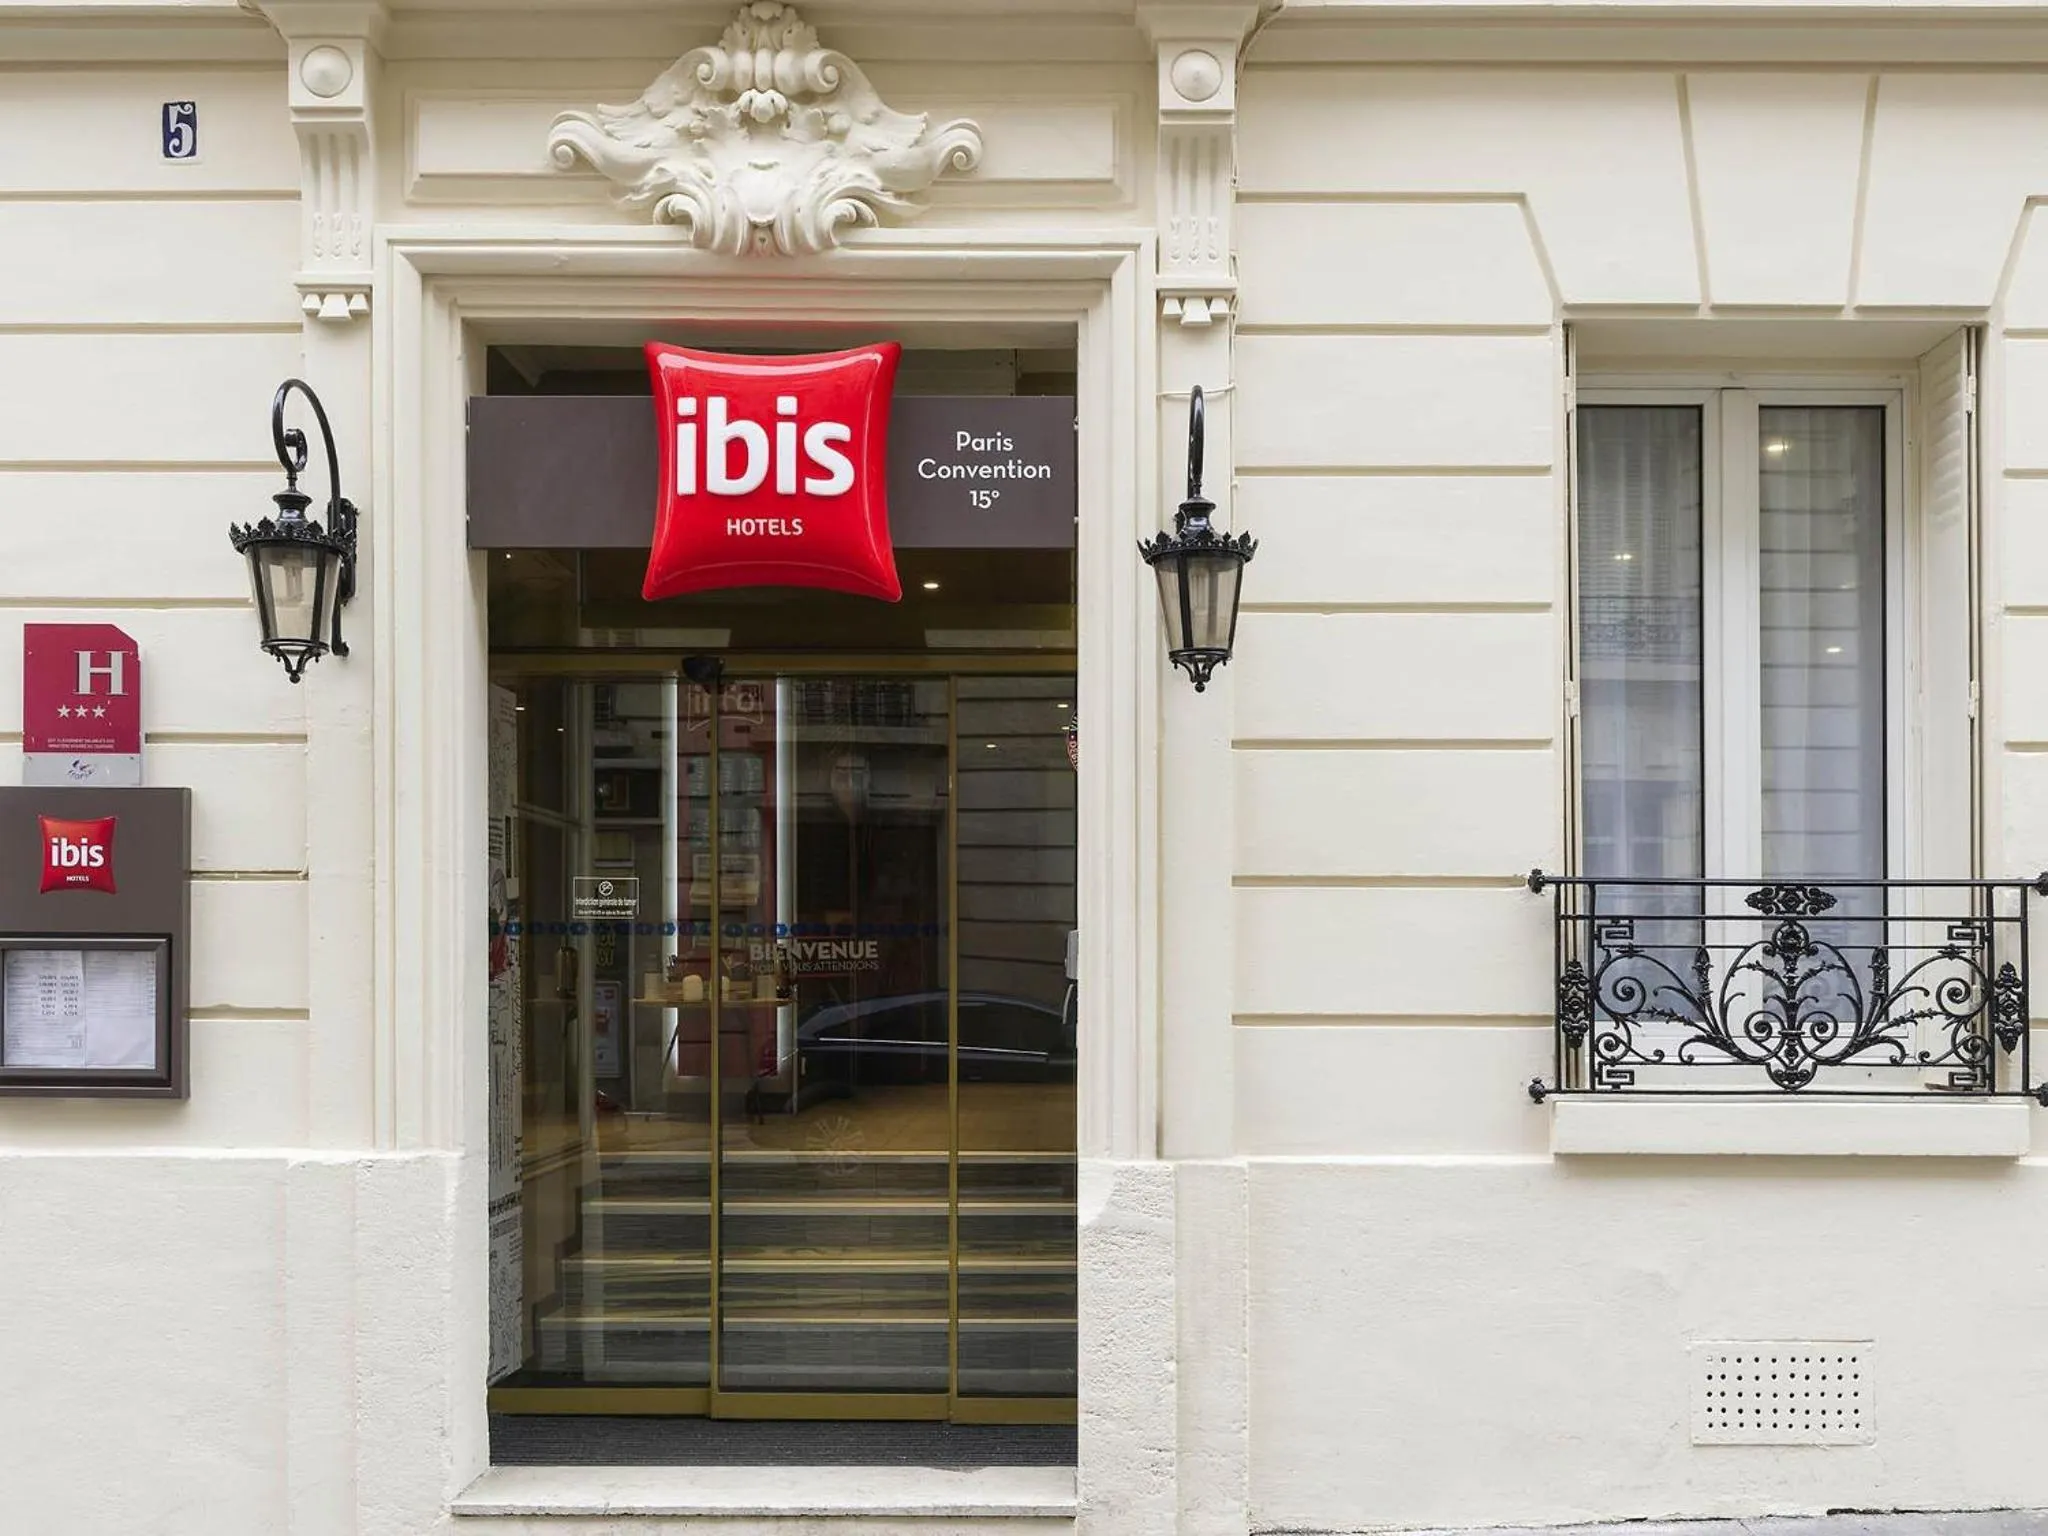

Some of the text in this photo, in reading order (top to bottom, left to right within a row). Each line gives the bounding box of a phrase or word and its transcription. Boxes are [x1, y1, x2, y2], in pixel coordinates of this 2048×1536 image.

[168, 103, 194, 157] 5
[676, 396, 855, 496] ibis
[956, 431, 1014, 451] Paris
[918, 458, 1051, 479] Convention
[726, 518, 803, 536] HOTELS
[73, 650, 129, 695] H
[51, 837, 104, 867] ibis
[750, 941, 878, 960] BIENVENUE
